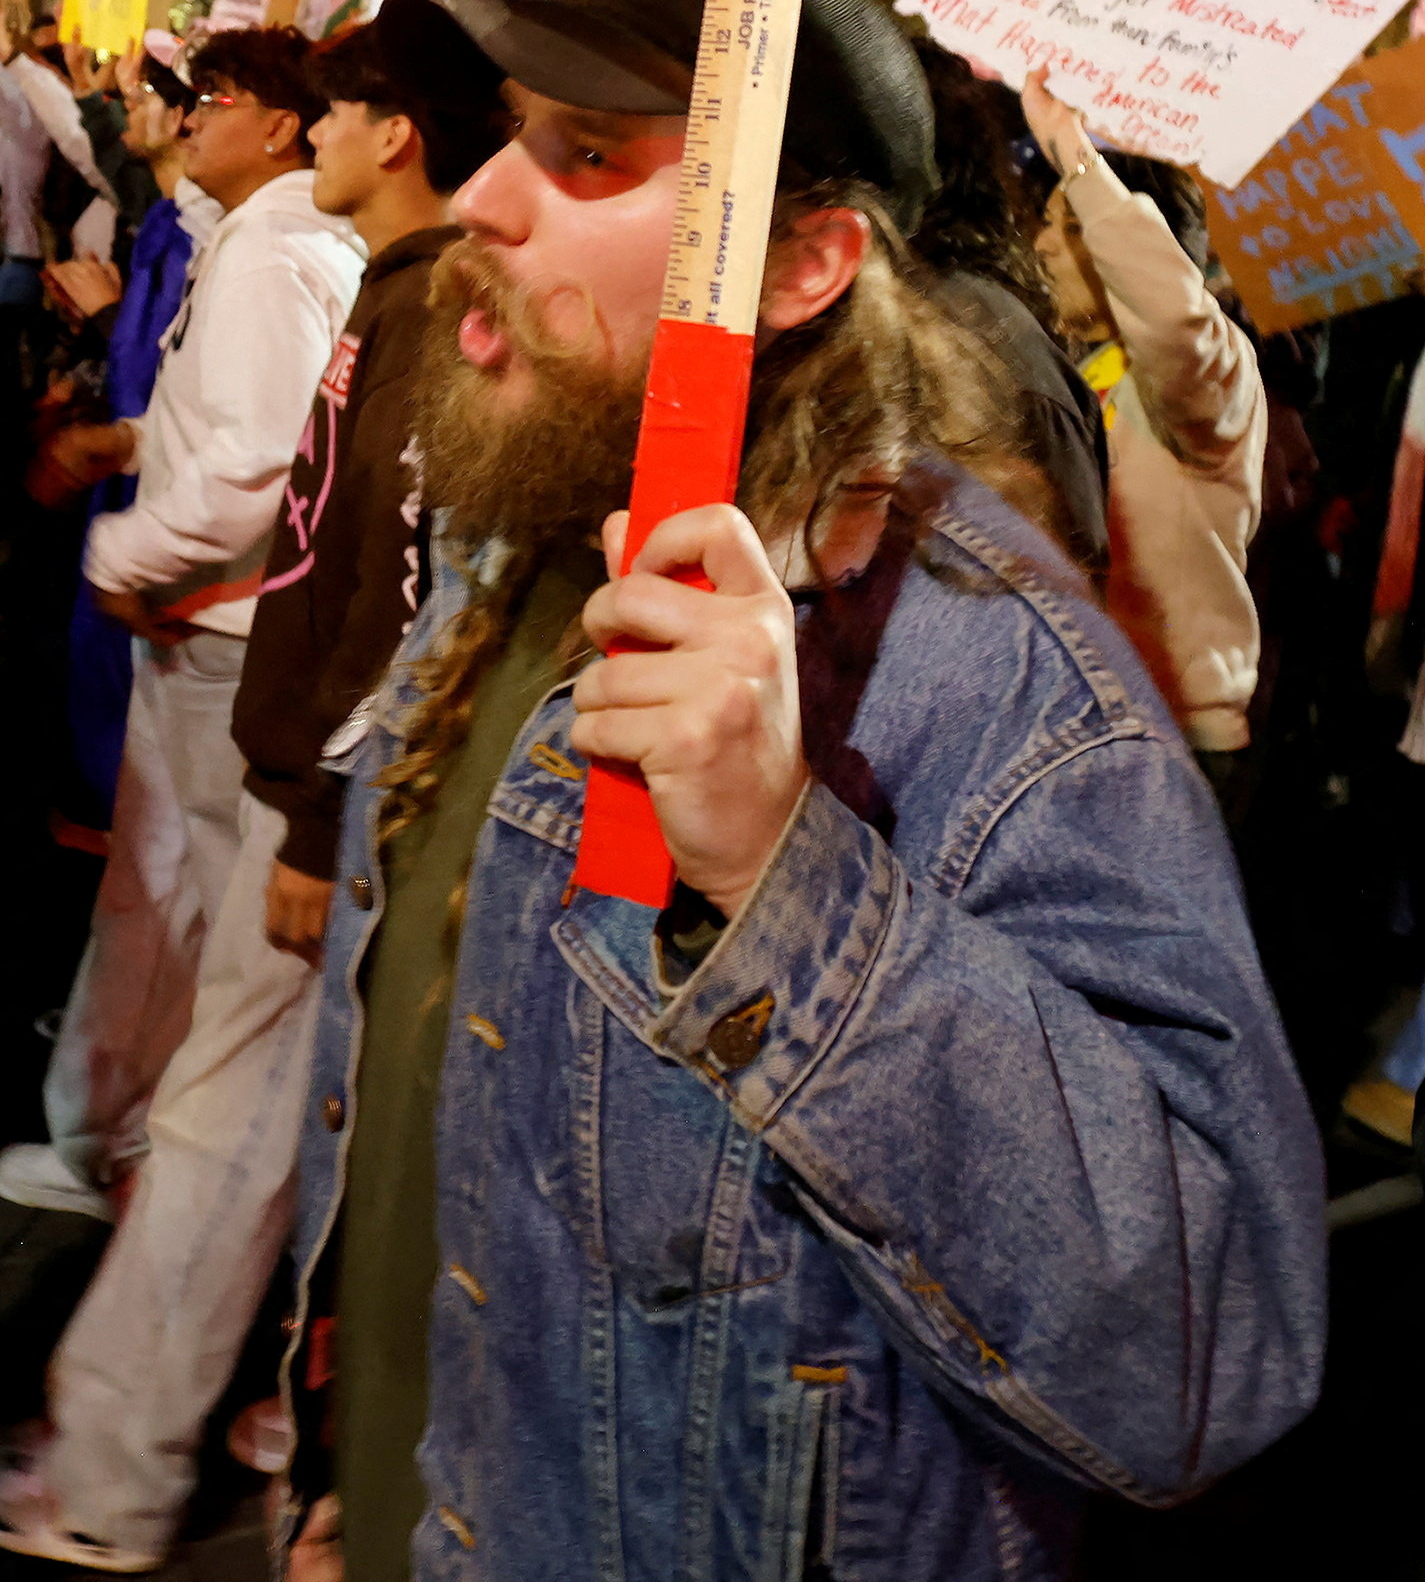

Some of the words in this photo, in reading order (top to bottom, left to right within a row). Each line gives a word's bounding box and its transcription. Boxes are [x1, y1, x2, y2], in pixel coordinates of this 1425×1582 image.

[715, 28, 731, 54] 12
[738, 10, 755, 49] JOB
[751, 29, 769, 76] Primer
[1137, 54, 1172, 88] to
[1180, 69, 1222, 100] the
[705, 98, 722, 120] 11
[695, 161, 712, 188] 10
[688, 231, 703, 247] 9
[714, 188, 736, 276] covered?
[710, 281, 723, 306] all
